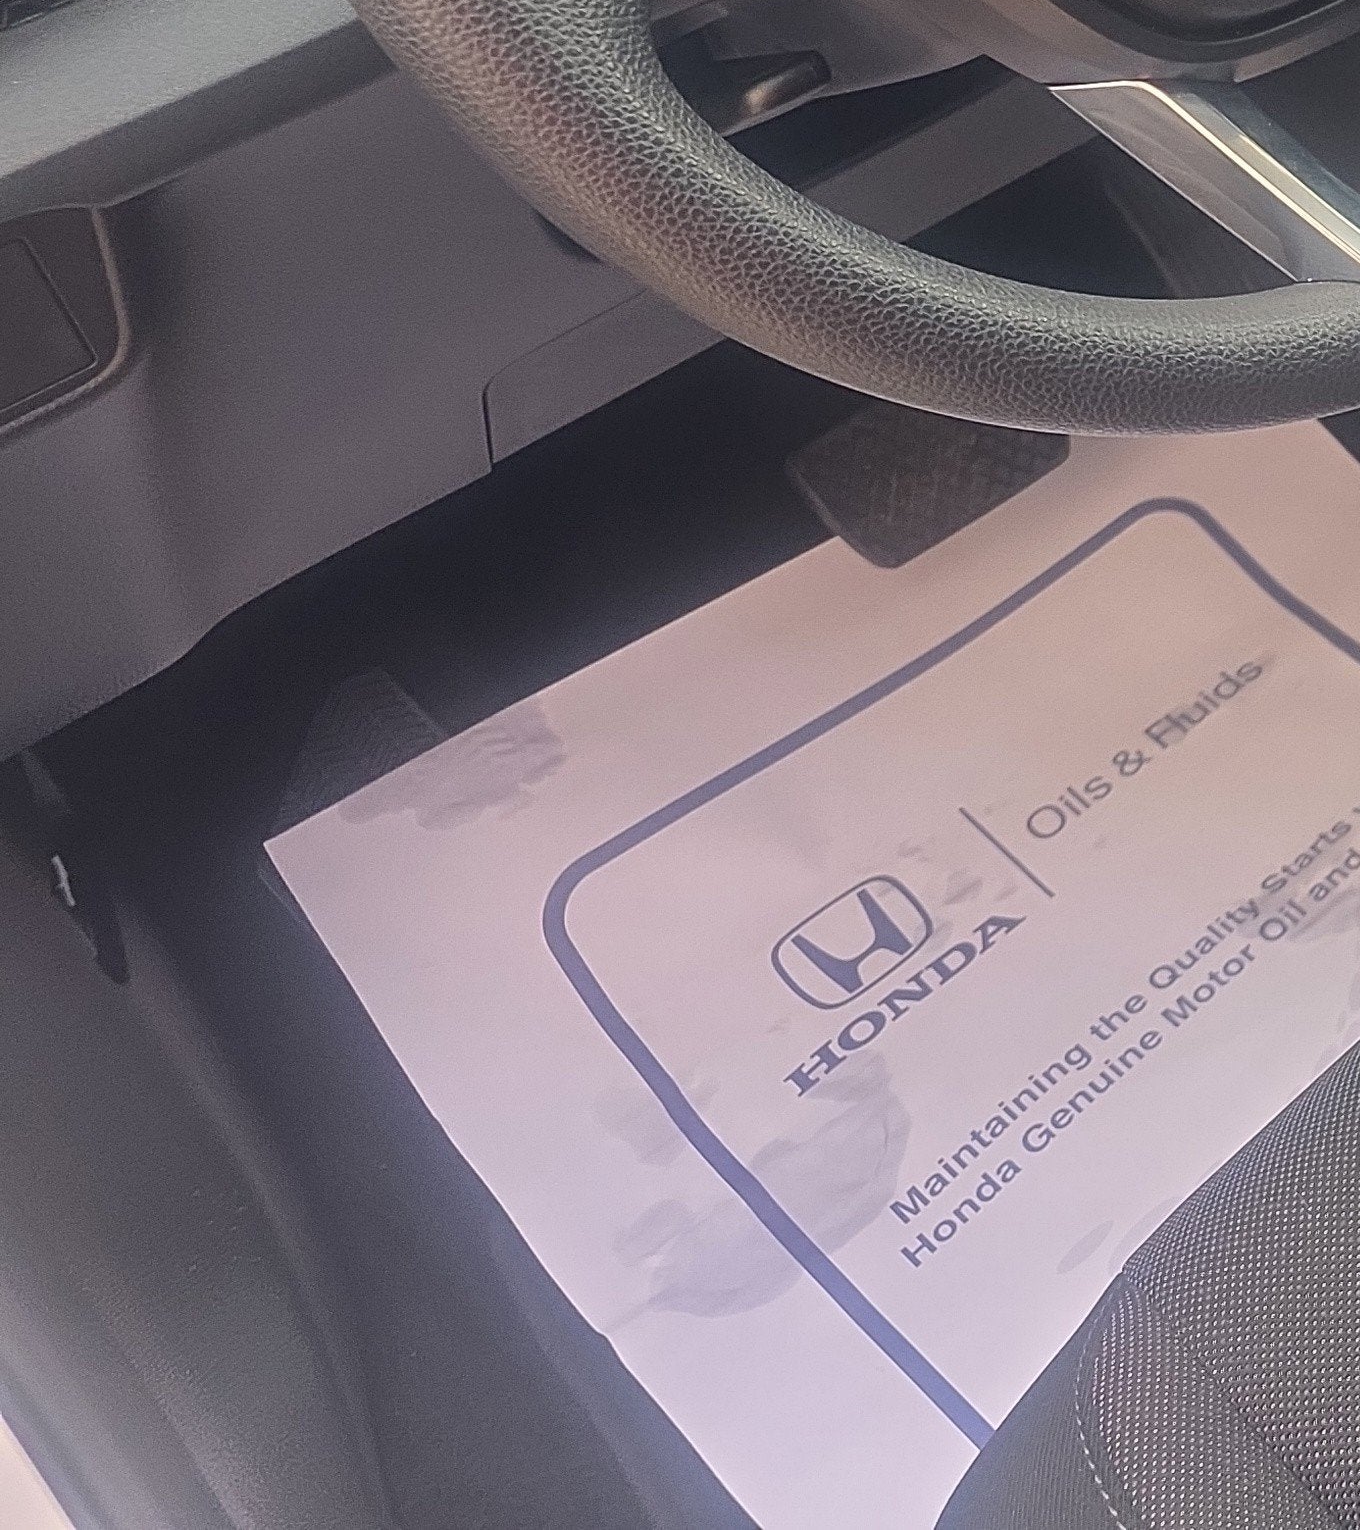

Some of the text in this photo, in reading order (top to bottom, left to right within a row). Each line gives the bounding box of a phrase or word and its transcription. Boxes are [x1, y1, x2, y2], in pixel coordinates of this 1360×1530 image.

[1026, 657, 1264, 841] Oils & Fluids
[783, 912, 1026, 1097] HONDA
[889, 1043, 1094, 1225] Maintaining
[1089, 990, 1149, 1043] the
[1149, 898, 1261, 992] Quality
[1259, 821, 1351, 897] Starts
[900, 1162, 1022, 1269] Honda
[1022, 1028, 1164, 1154] Genuine
[1161, 942, 1256, 1030] Motor
[1258, 898, 1308, 943] Oil
